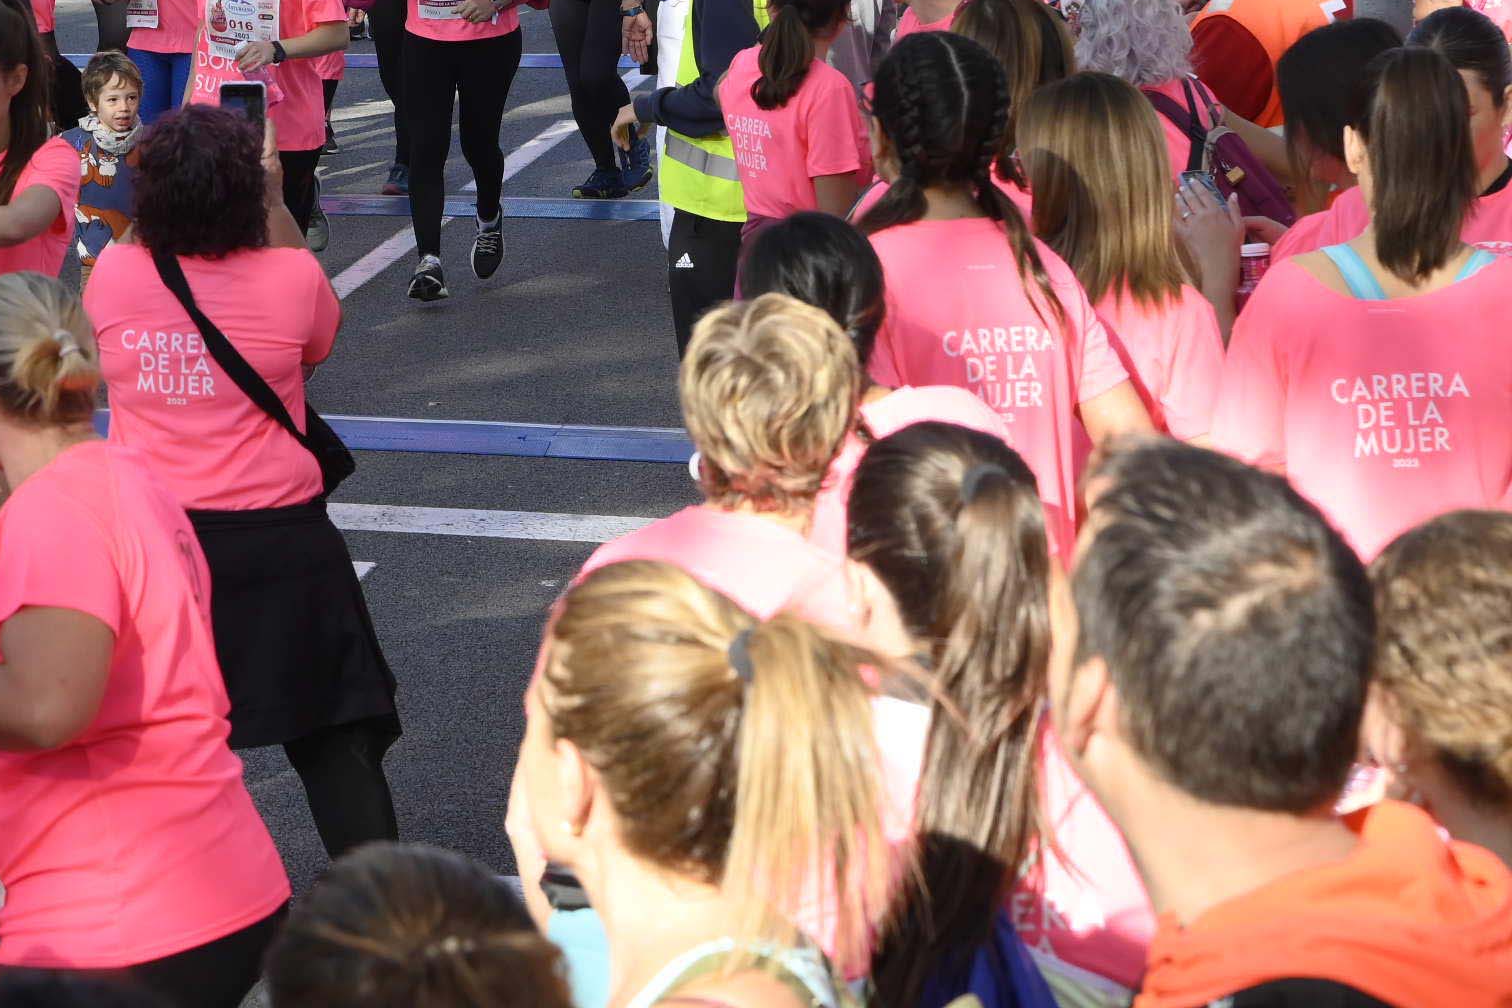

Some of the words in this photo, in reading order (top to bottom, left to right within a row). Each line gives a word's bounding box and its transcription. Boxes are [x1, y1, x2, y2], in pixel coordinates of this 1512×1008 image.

[229, 19, 254, 31] 016
[727, 113, 773, 140] CARRERA
[736, 132, 749, 151] DE
[750, 135, 764, 155] LA
[736, 150, 768, 171] MUJER
[942, 325, 1057, 358] CARRERA
[139, 351, 170, 373] DE
[180, 354, 211, 376] LA
[966, 354, 998, 384] DE
[1006, 353, 1038, 380] LA
[136, 372, 216, 397] MUJER
[1330, 372, 1471, 405] CARRERA
[1357, 401, 1396, 430] DE
[1407, 400, 1445, 426] LA
[1353, 426, 1452, 459] MUJER
